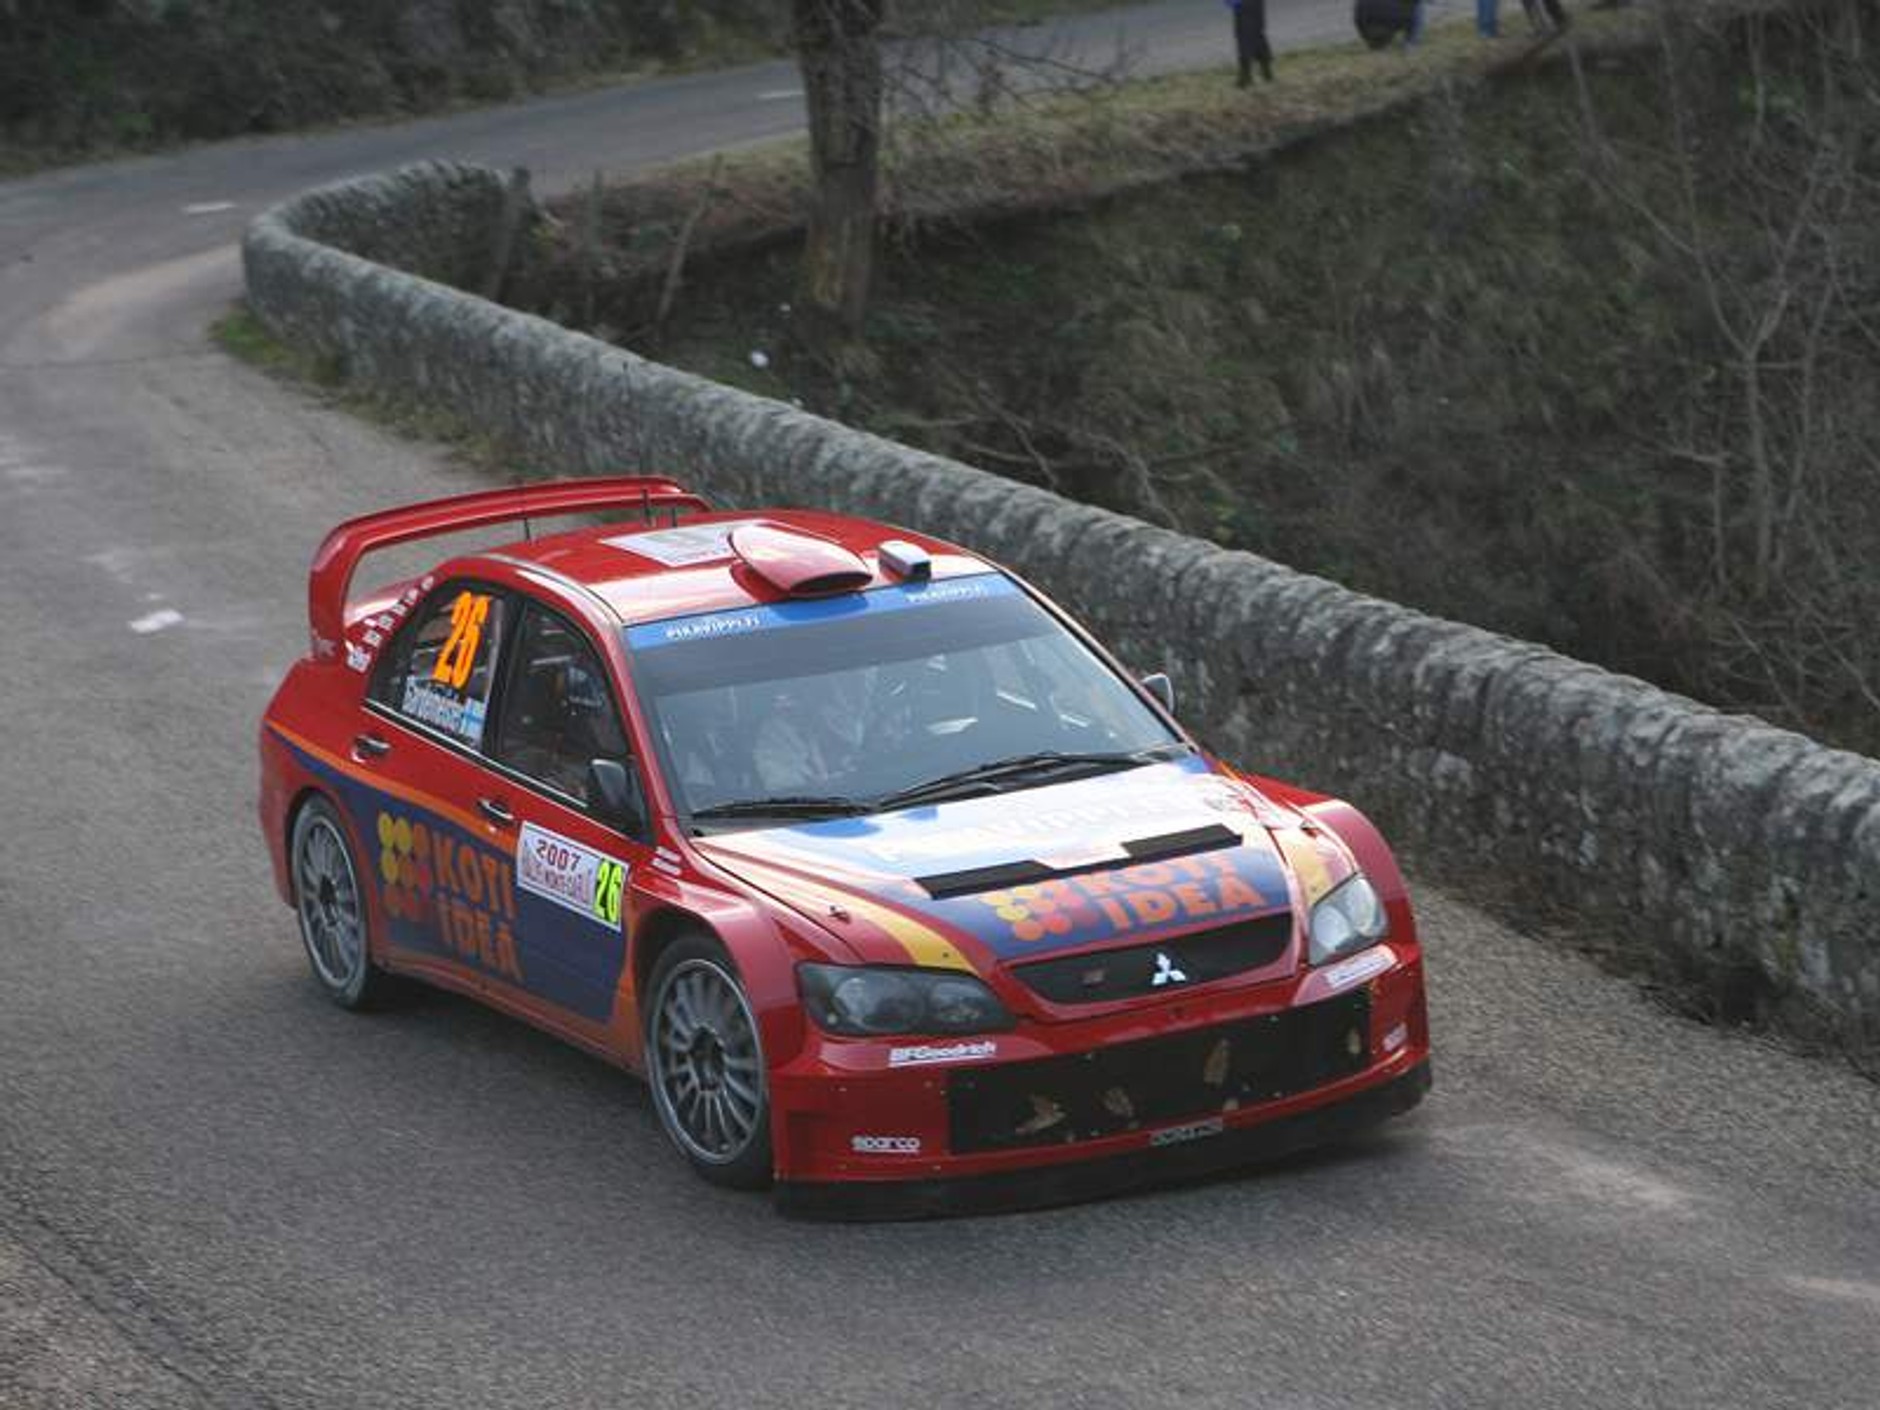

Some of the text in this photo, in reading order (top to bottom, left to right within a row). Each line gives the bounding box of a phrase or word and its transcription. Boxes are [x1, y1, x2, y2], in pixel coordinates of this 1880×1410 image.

[432, 591, 491, 690] 26
[431, 828, 516, 920] KOTI
[536, 838, 581, 872] 2007
[593, 860, 622, 923] 26
[1101, 869, 1267, 932] IDEA
[888, 1041, 997, 1068] BFGoodrich
[852, 1136, 921, 1153] sparco
